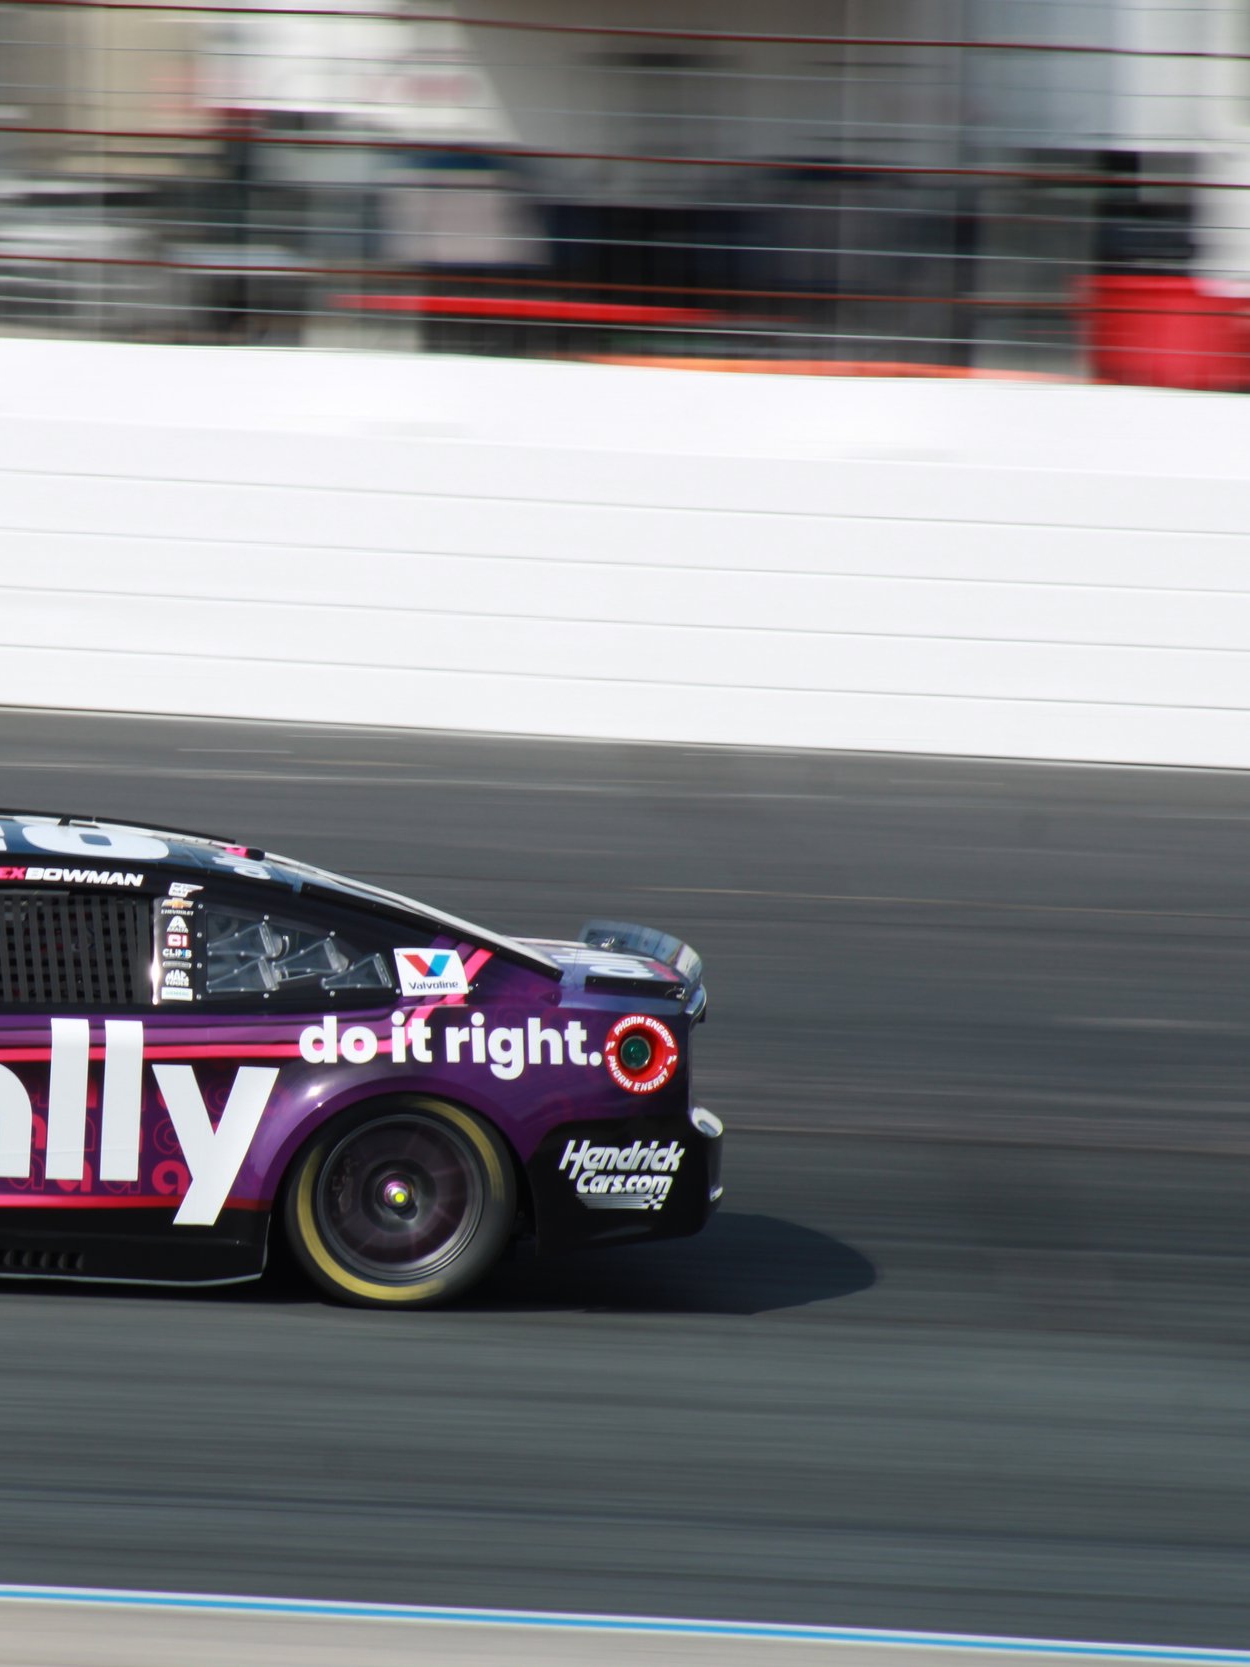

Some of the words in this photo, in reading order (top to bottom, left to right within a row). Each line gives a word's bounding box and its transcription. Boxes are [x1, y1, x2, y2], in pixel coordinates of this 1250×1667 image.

[408, 980, 459, 991] Valvoline
[299, 1015, 378, 1064] do
[391, 1010, 433, 1064] it
[445, 1012, 603, 1080] right.
[645, 1018, 675, 1048] ENERGY
[633, 1067, 669, 1092] ENERGY
[558, 1139, 686, 1180] Hendrick
[576, 1170, 674, 1194] Cars.com
